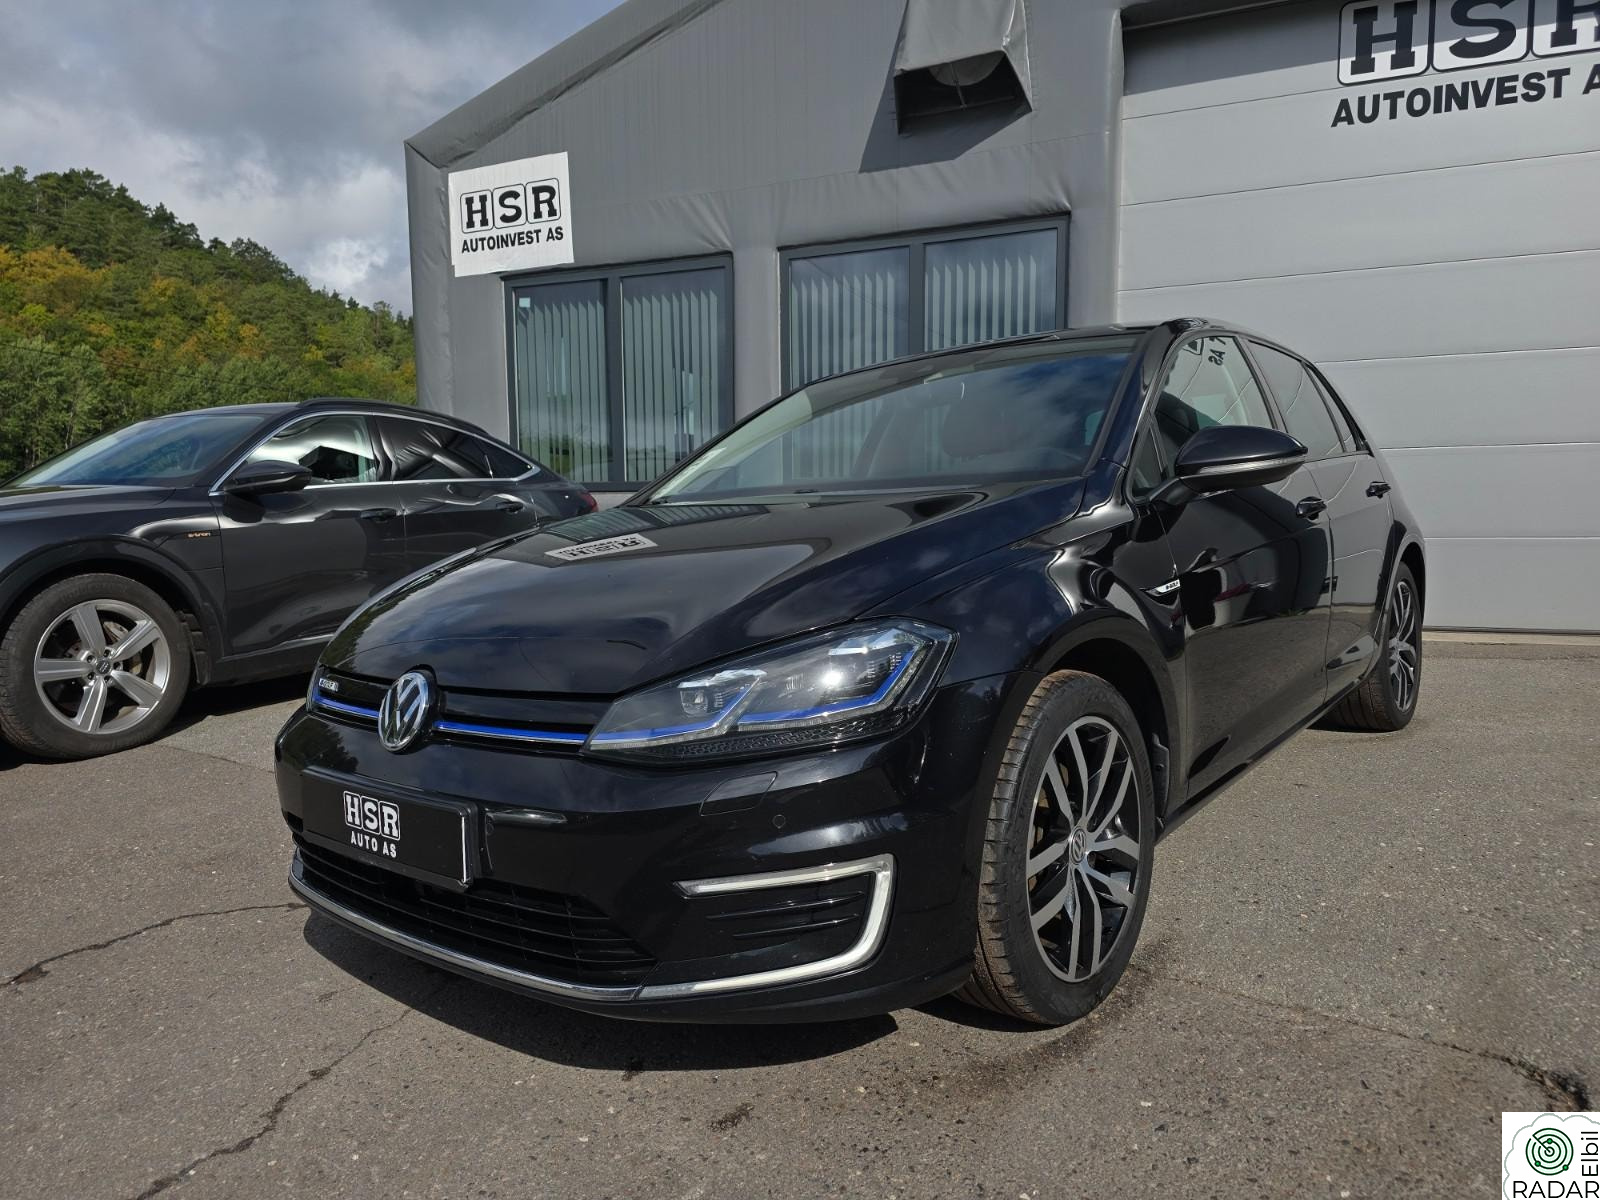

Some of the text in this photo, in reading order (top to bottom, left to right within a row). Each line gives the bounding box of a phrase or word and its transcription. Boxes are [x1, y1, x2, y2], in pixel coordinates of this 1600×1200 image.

[1330, 67, 1571, 128] AUTOINVEST
[465, 184, 558, 229] HSR
[461, 226, 564, 253] AUTOINVEST AS
[345, 794, 399, 838] HSR
[351, 831, 397, 859] AUTO AS
